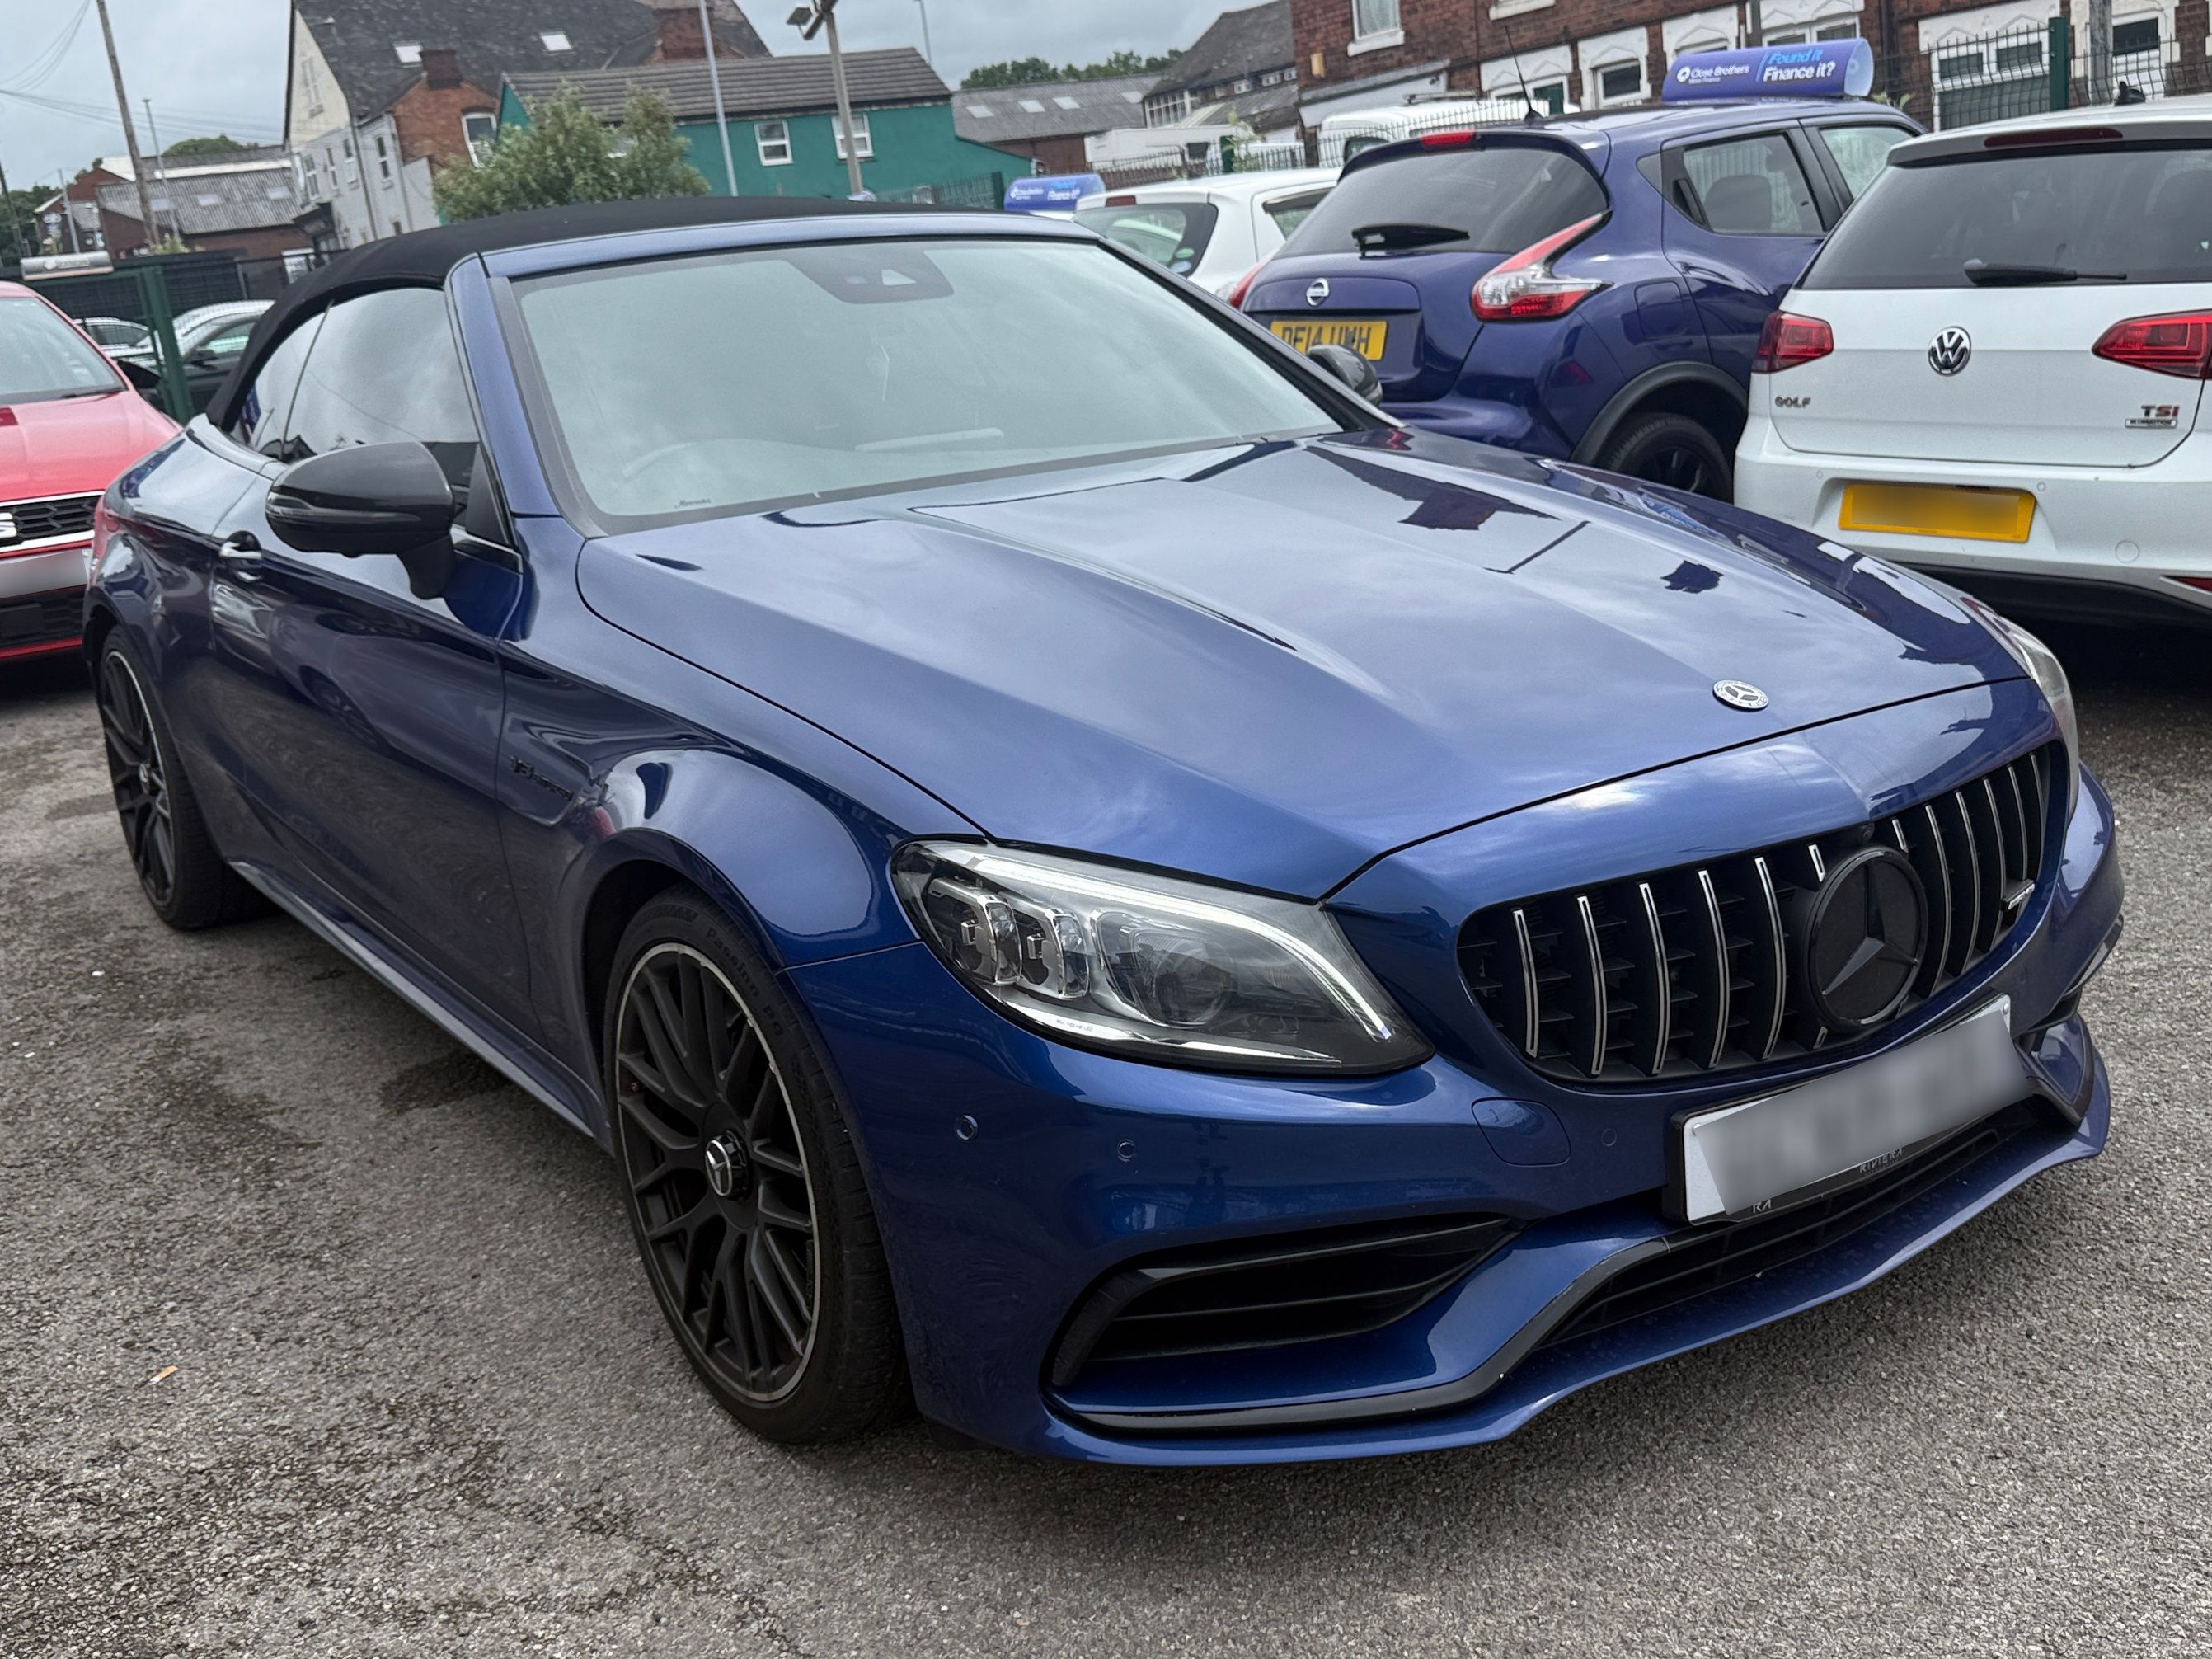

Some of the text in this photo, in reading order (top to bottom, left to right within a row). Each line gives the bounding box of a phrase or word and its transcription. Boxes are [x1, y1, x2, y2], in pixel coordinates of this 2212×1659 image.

[1768, 48, 1823, 64] Found it
[1690, 64, 1749, 78] Close Brothers
[1763, 60, 1836, 82] Finance it?
[1774, 396, 1811, 408] GOLF
[2140, 405, 2180, 417] TSI
[705, 927, 758, 996] Passion
[1859, 1148, 1903, 1173] RIVIERA
